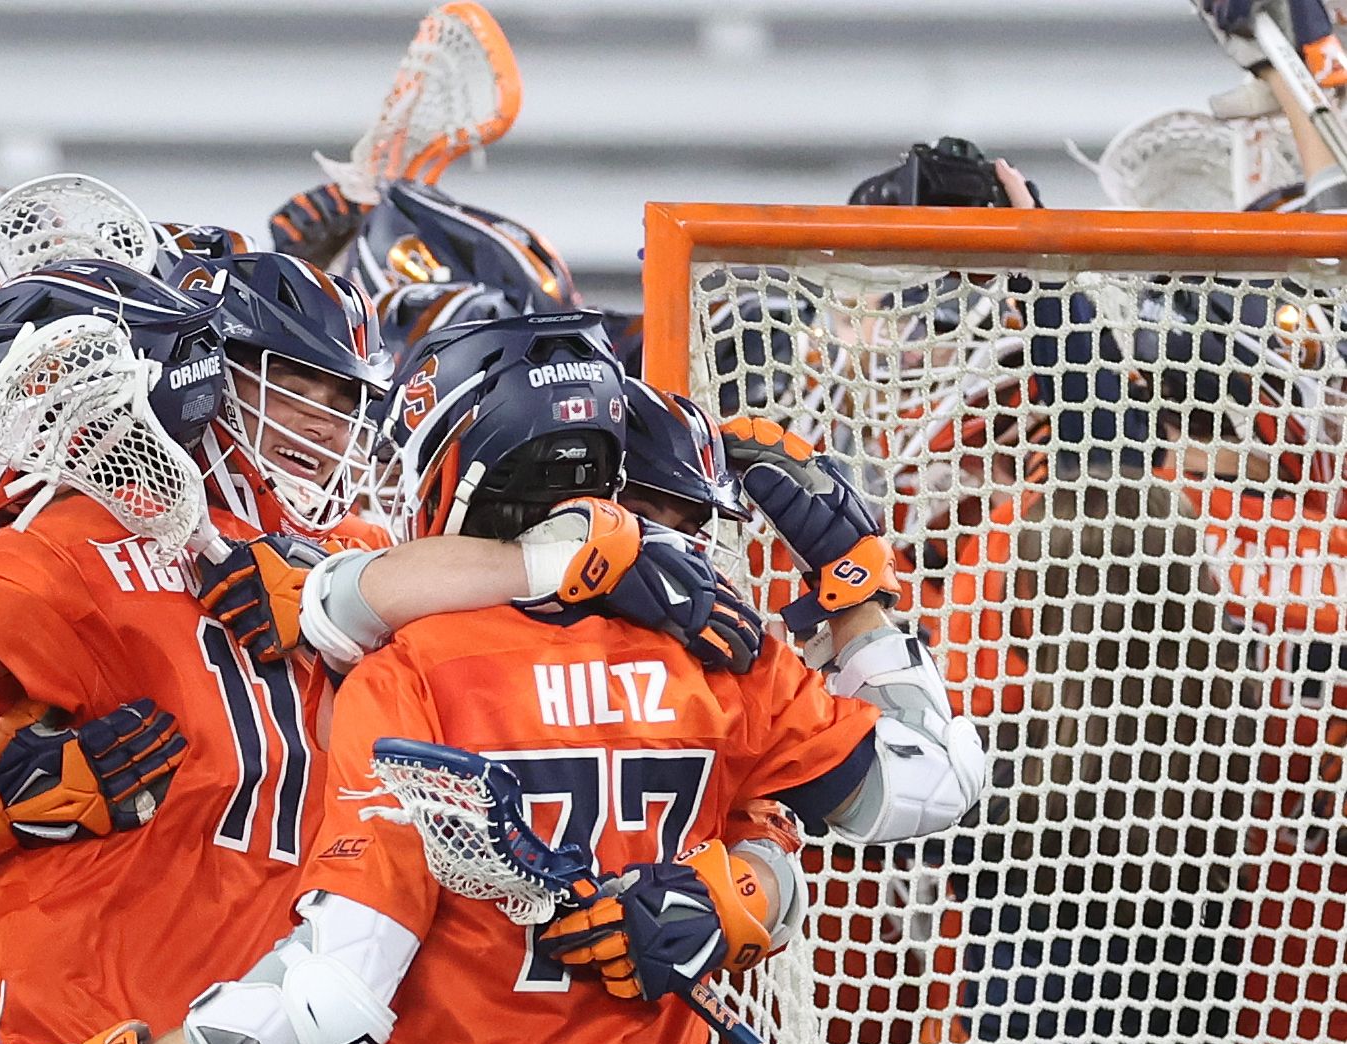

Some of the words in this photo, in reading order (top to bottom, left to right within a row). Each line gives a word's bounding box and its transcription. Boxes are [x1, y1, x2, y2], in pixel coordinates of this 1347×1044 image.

[169, 355, 222, 390] ORANGE
[402, 354, 440, 433] S
[528, 361, 603, 389] ORANGE
[829, 557, 871, 587] S
[533, 660, 677, 727] HILTZ
[195, 615, 312, 867] 11
[320, 837, 370, 856] ACC
[477, 747, 716, 993] 77
[735, 872, 757, 897] 19
[690, 982, 741, 1031] GAIT
